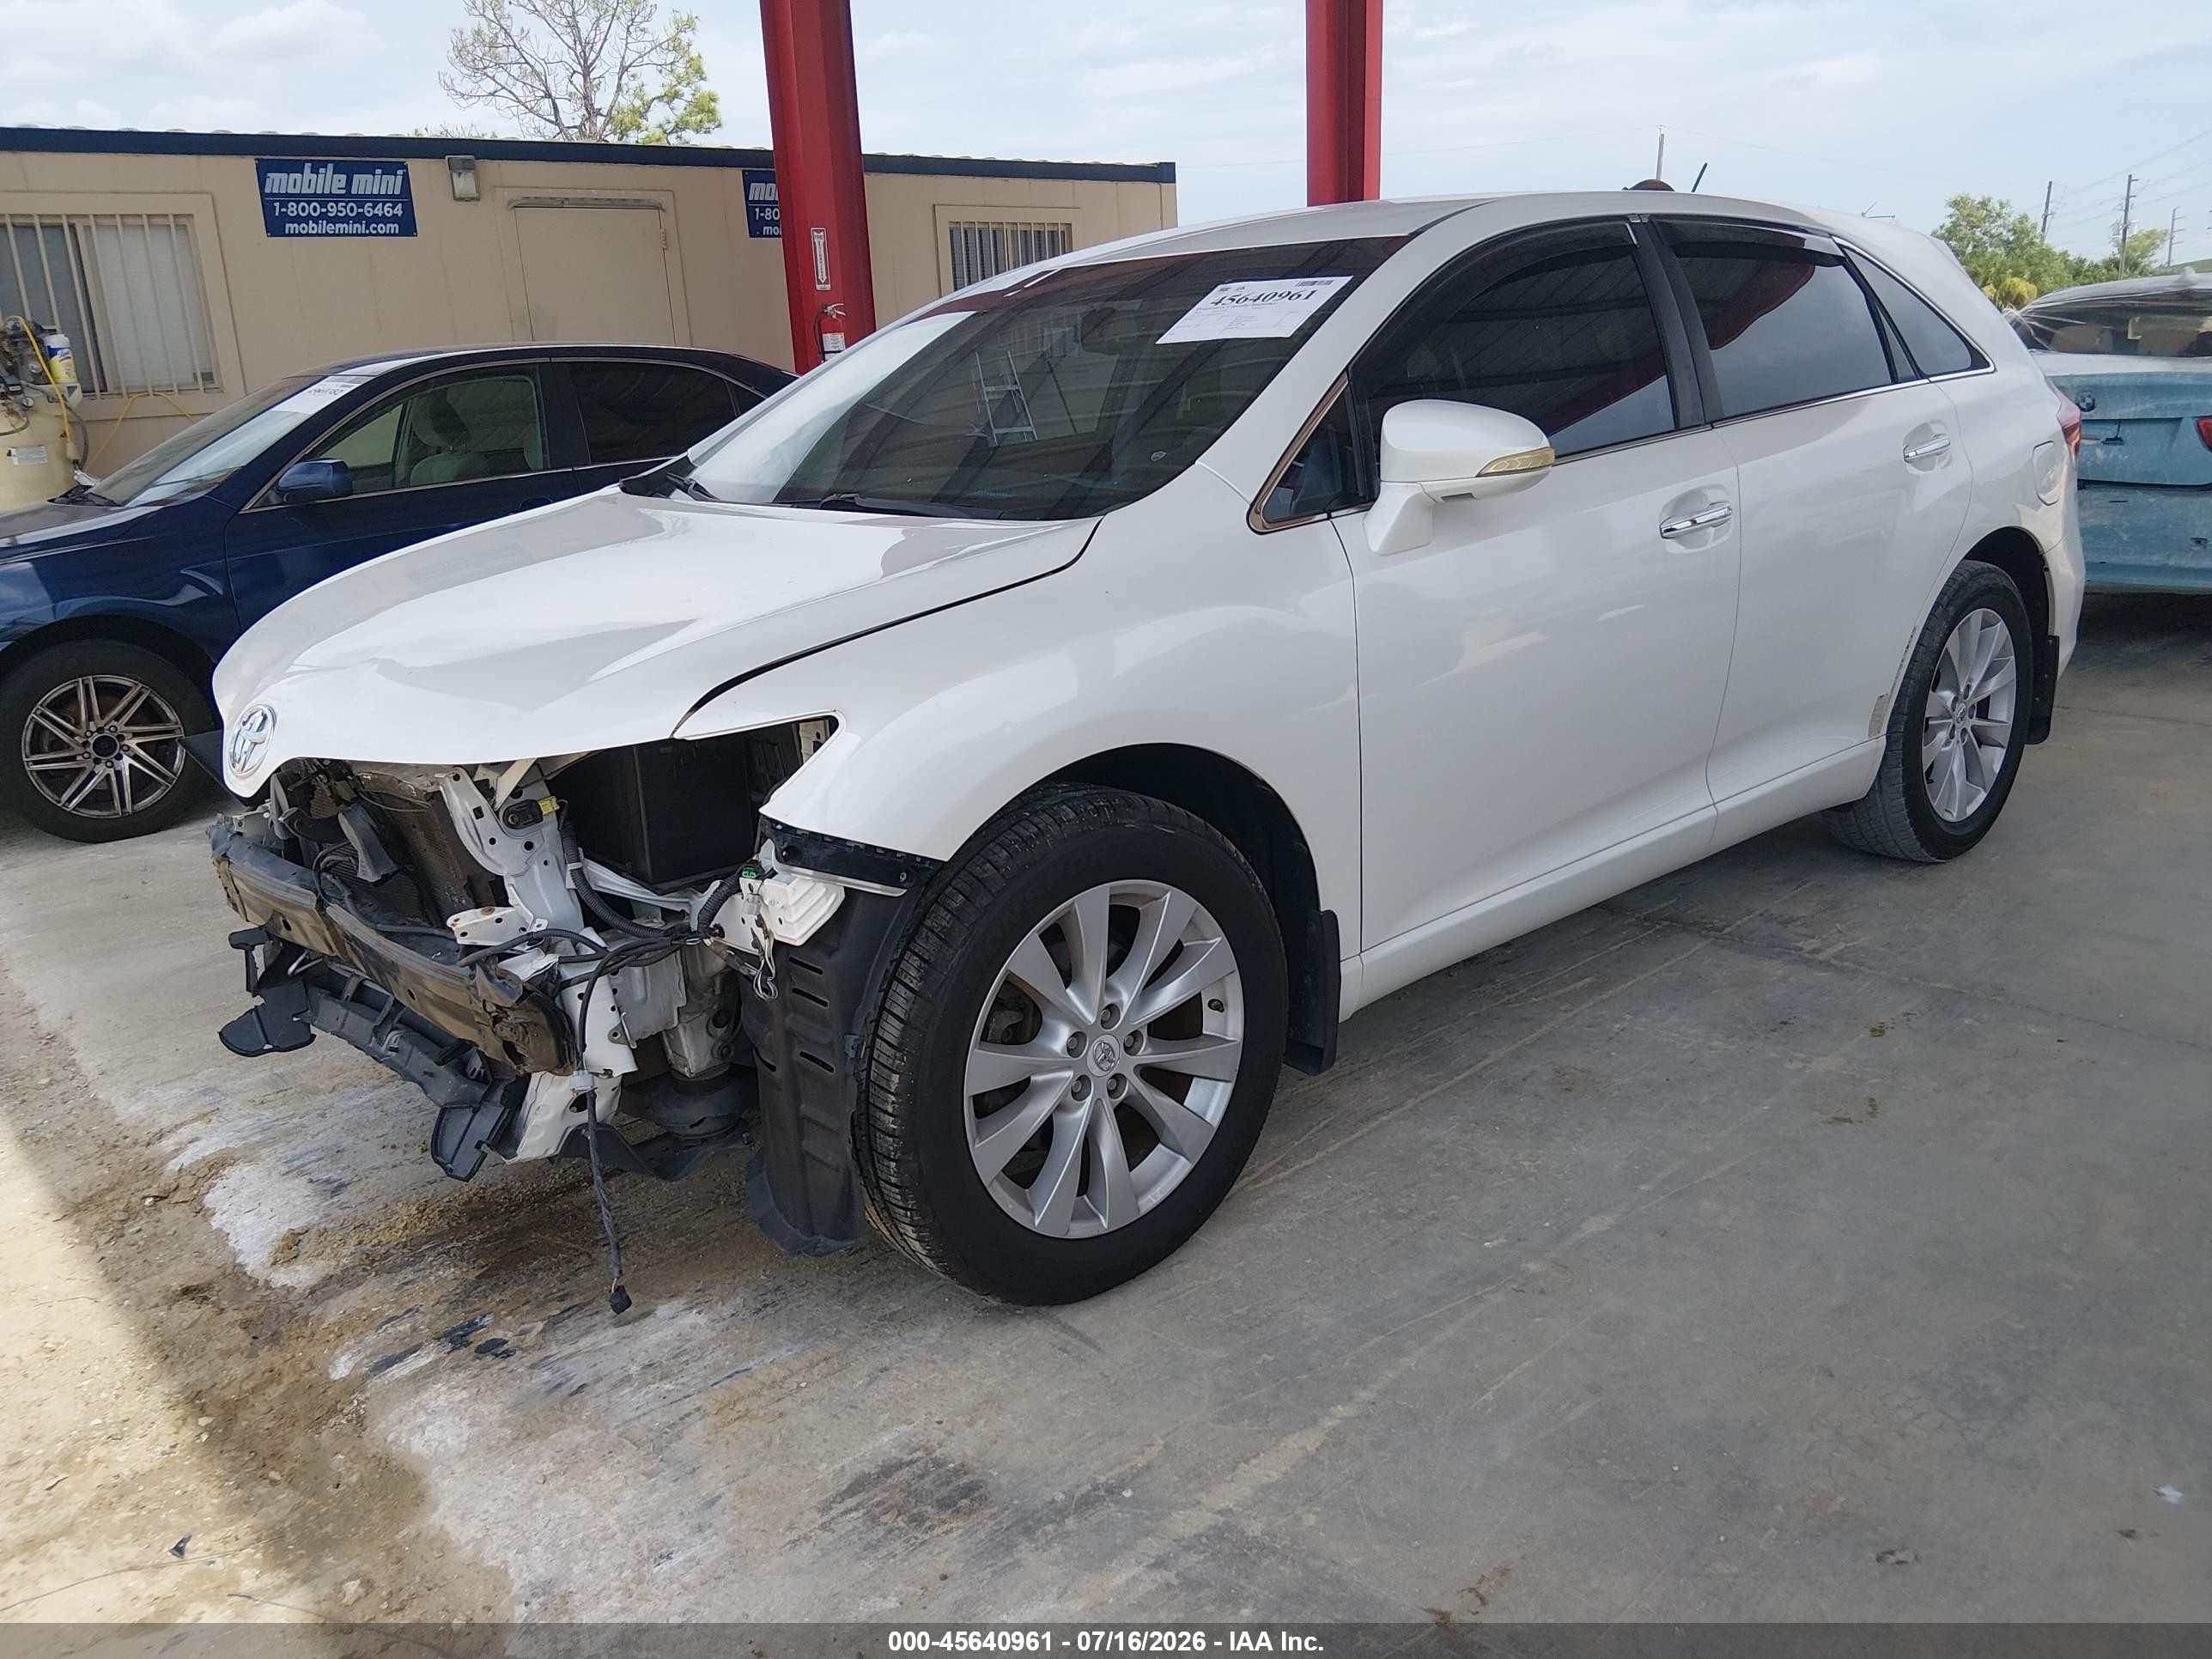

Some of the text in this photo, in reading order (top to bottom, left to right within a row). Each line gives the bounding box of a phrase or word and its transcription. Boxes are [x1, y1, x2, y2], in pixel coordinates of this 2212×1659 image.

[264, 162, 404, 195] mobile mini
[748, 182, 779, 201] mo
[273, 201, 403, 217] 1-800-950-6464
[285, 220, 399, 234] mobilemini.com
[763, 225, 782, 235] mo
[1211, 290, 1318, 306] 45640961
